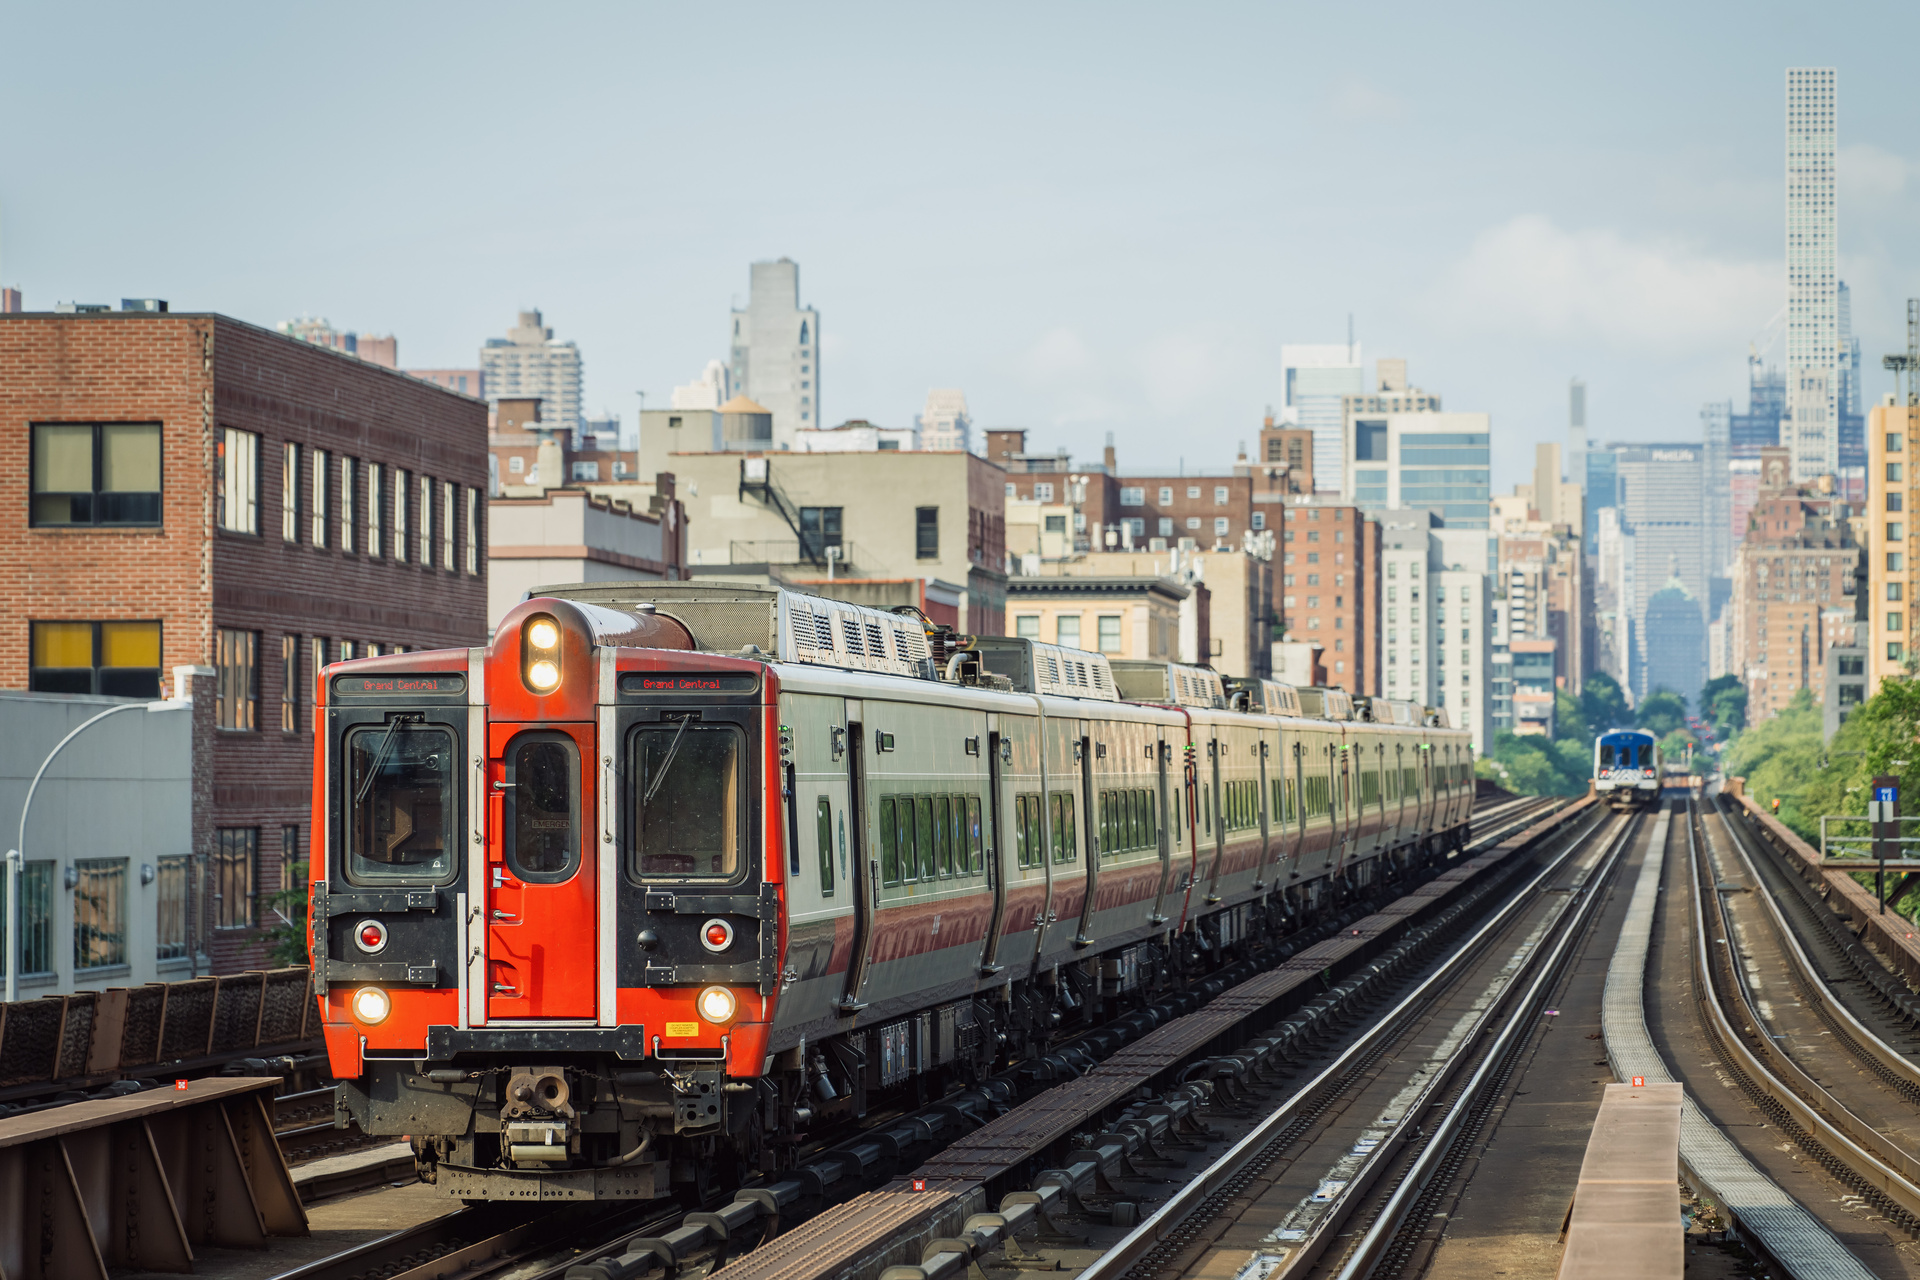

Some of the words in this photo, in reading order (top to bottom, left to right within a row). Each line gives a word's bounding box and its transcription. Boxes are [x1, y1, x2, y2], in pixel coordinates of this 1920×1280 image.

[363, 680, 393, 690] Grand
[398, 680, 438, 690] Central
[643, 679, 674, 689] Grand
[679, 679, 720, 689] Central
